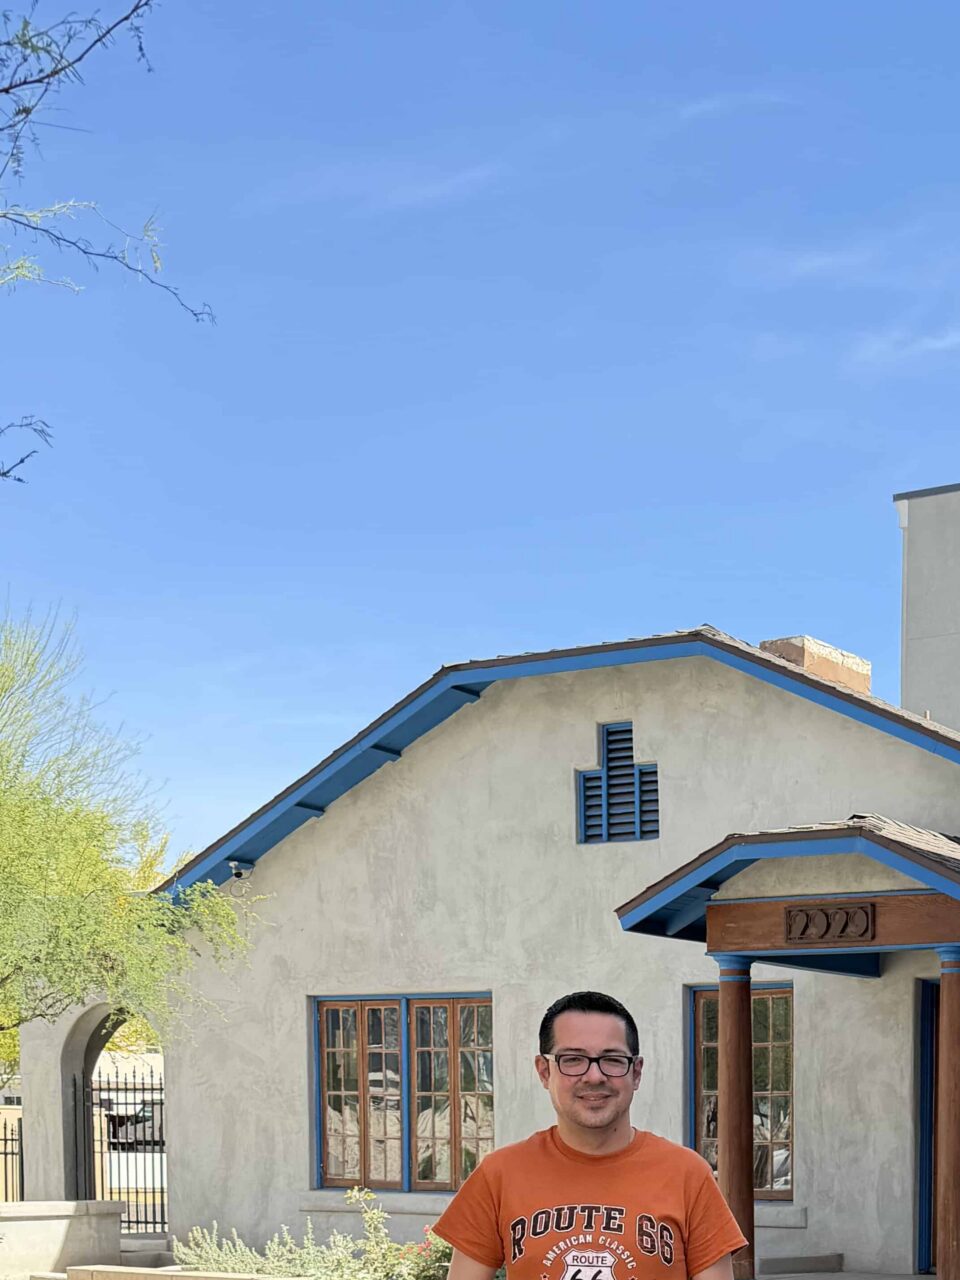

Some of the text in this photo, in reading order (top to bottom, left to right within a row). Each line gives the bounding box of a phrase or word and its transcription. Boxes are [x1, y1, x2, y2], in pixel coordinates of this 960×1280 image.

[510, 1205, 675, 1266] ROUTE 66
[542, 1234, 637, 1269] AMERICAN CLASSIC
[572, 1255, 608, 1265] ROUTE
